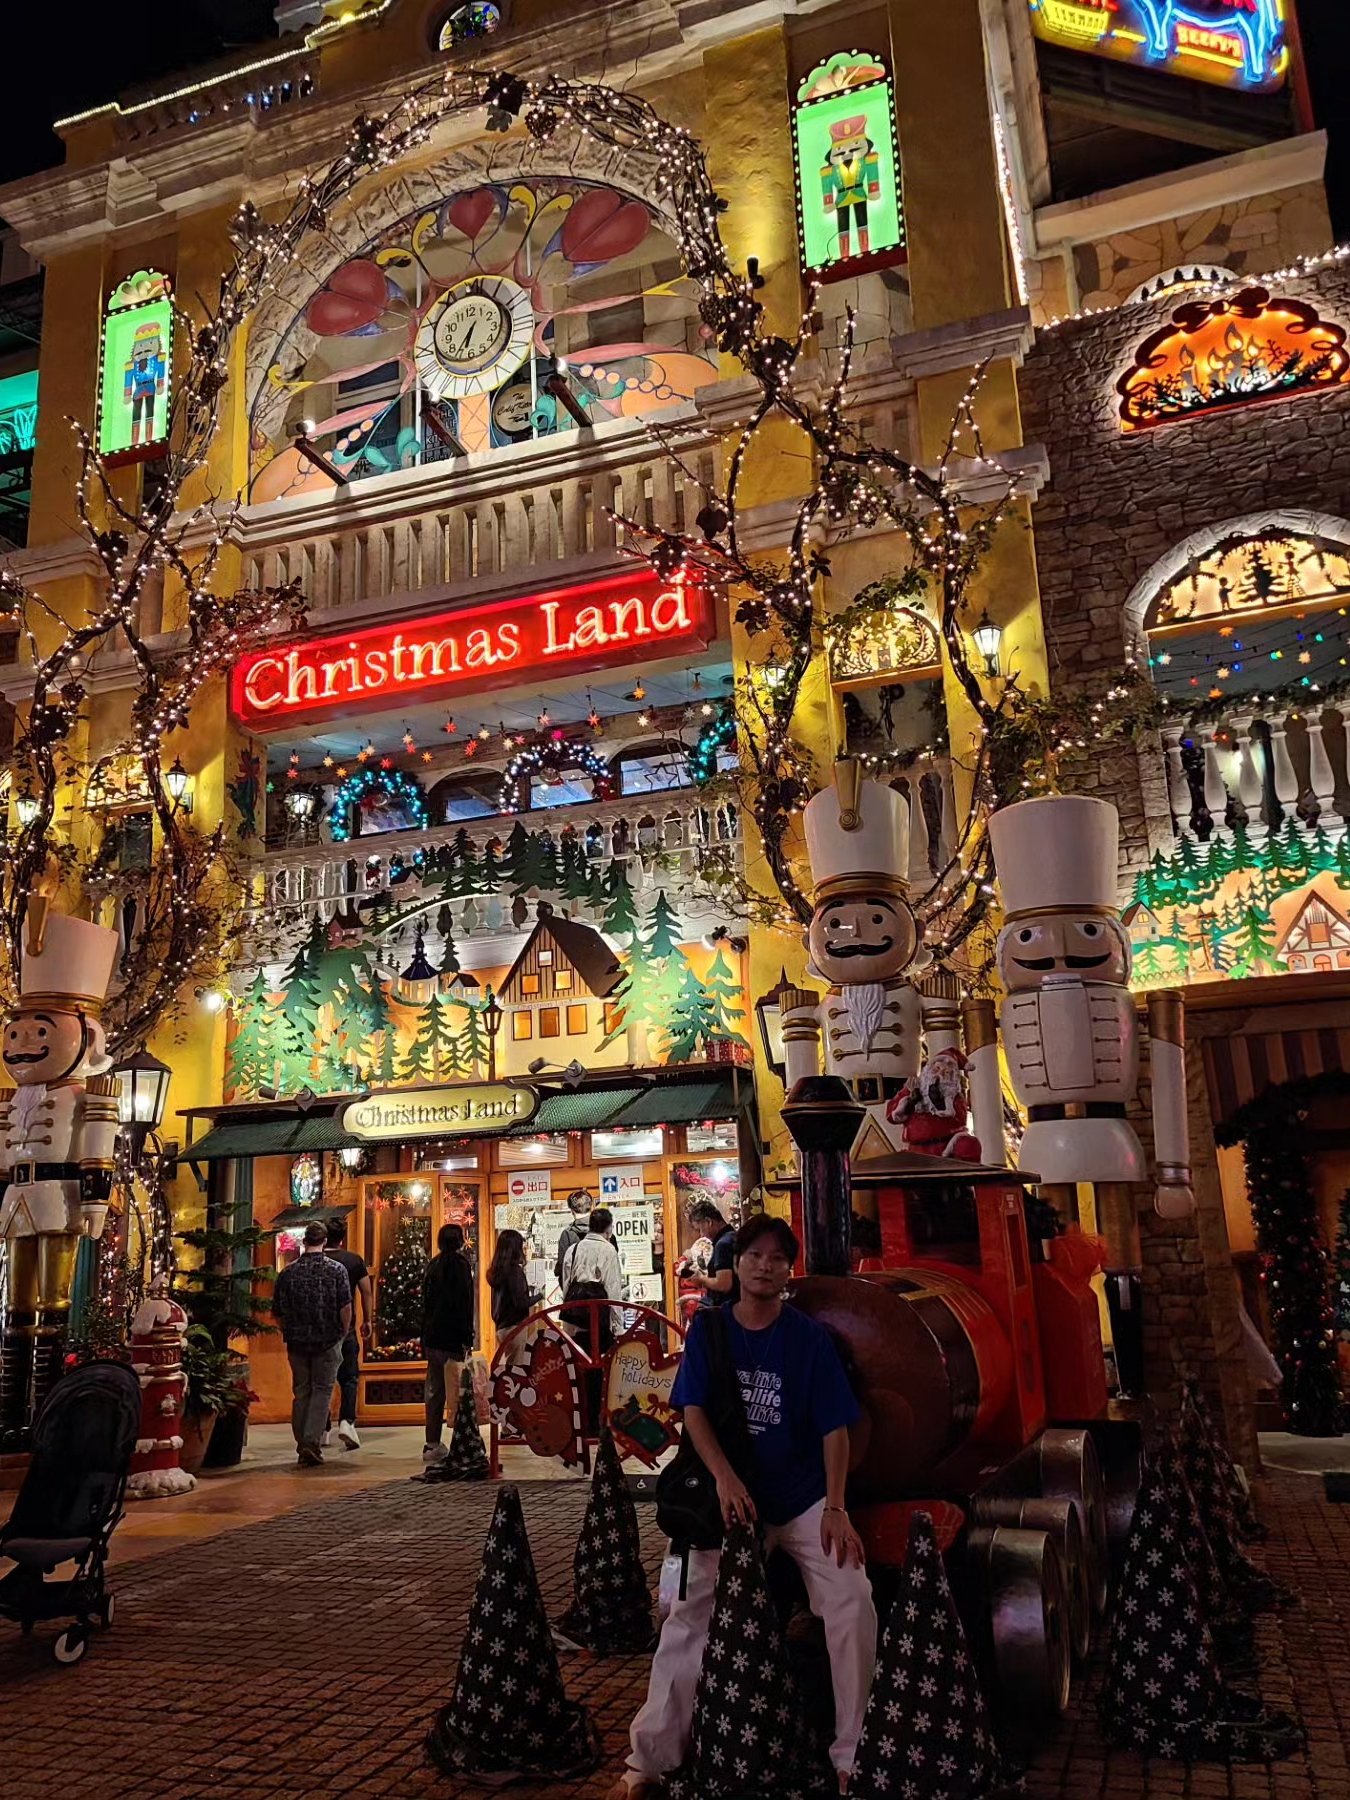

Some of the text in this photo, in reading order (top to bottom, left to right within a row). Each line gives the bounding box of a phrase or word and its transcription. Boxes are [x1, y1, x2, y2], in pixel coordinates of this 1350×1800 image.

[456, 312, 464, 323] 11
[466, 306, 476, 318] 12
[486, 311, 493, 321] 2
[446, 322, 458, 333] 10
[490, 321, 498, 331] 3
[445, 334, 452, 344] 9
[486, 333, 494, 343] 4
[448, 343, 456, 353] 8
[467, 348, 475, 359] 6
[479, 343, 486, 353] 5
[245, 570, 692, 710] Christmas Land
[356, 1094, 518, 1129] Christmas Land
[527, 1181, 548, 1192] 出口
[619, 1176, 640, 1189] 入口
[632, 1210, 648, 1218] WE'RE
[615, 1220, 648, 1237] OPEN
[615, 1351, 647, 1371] Happy
